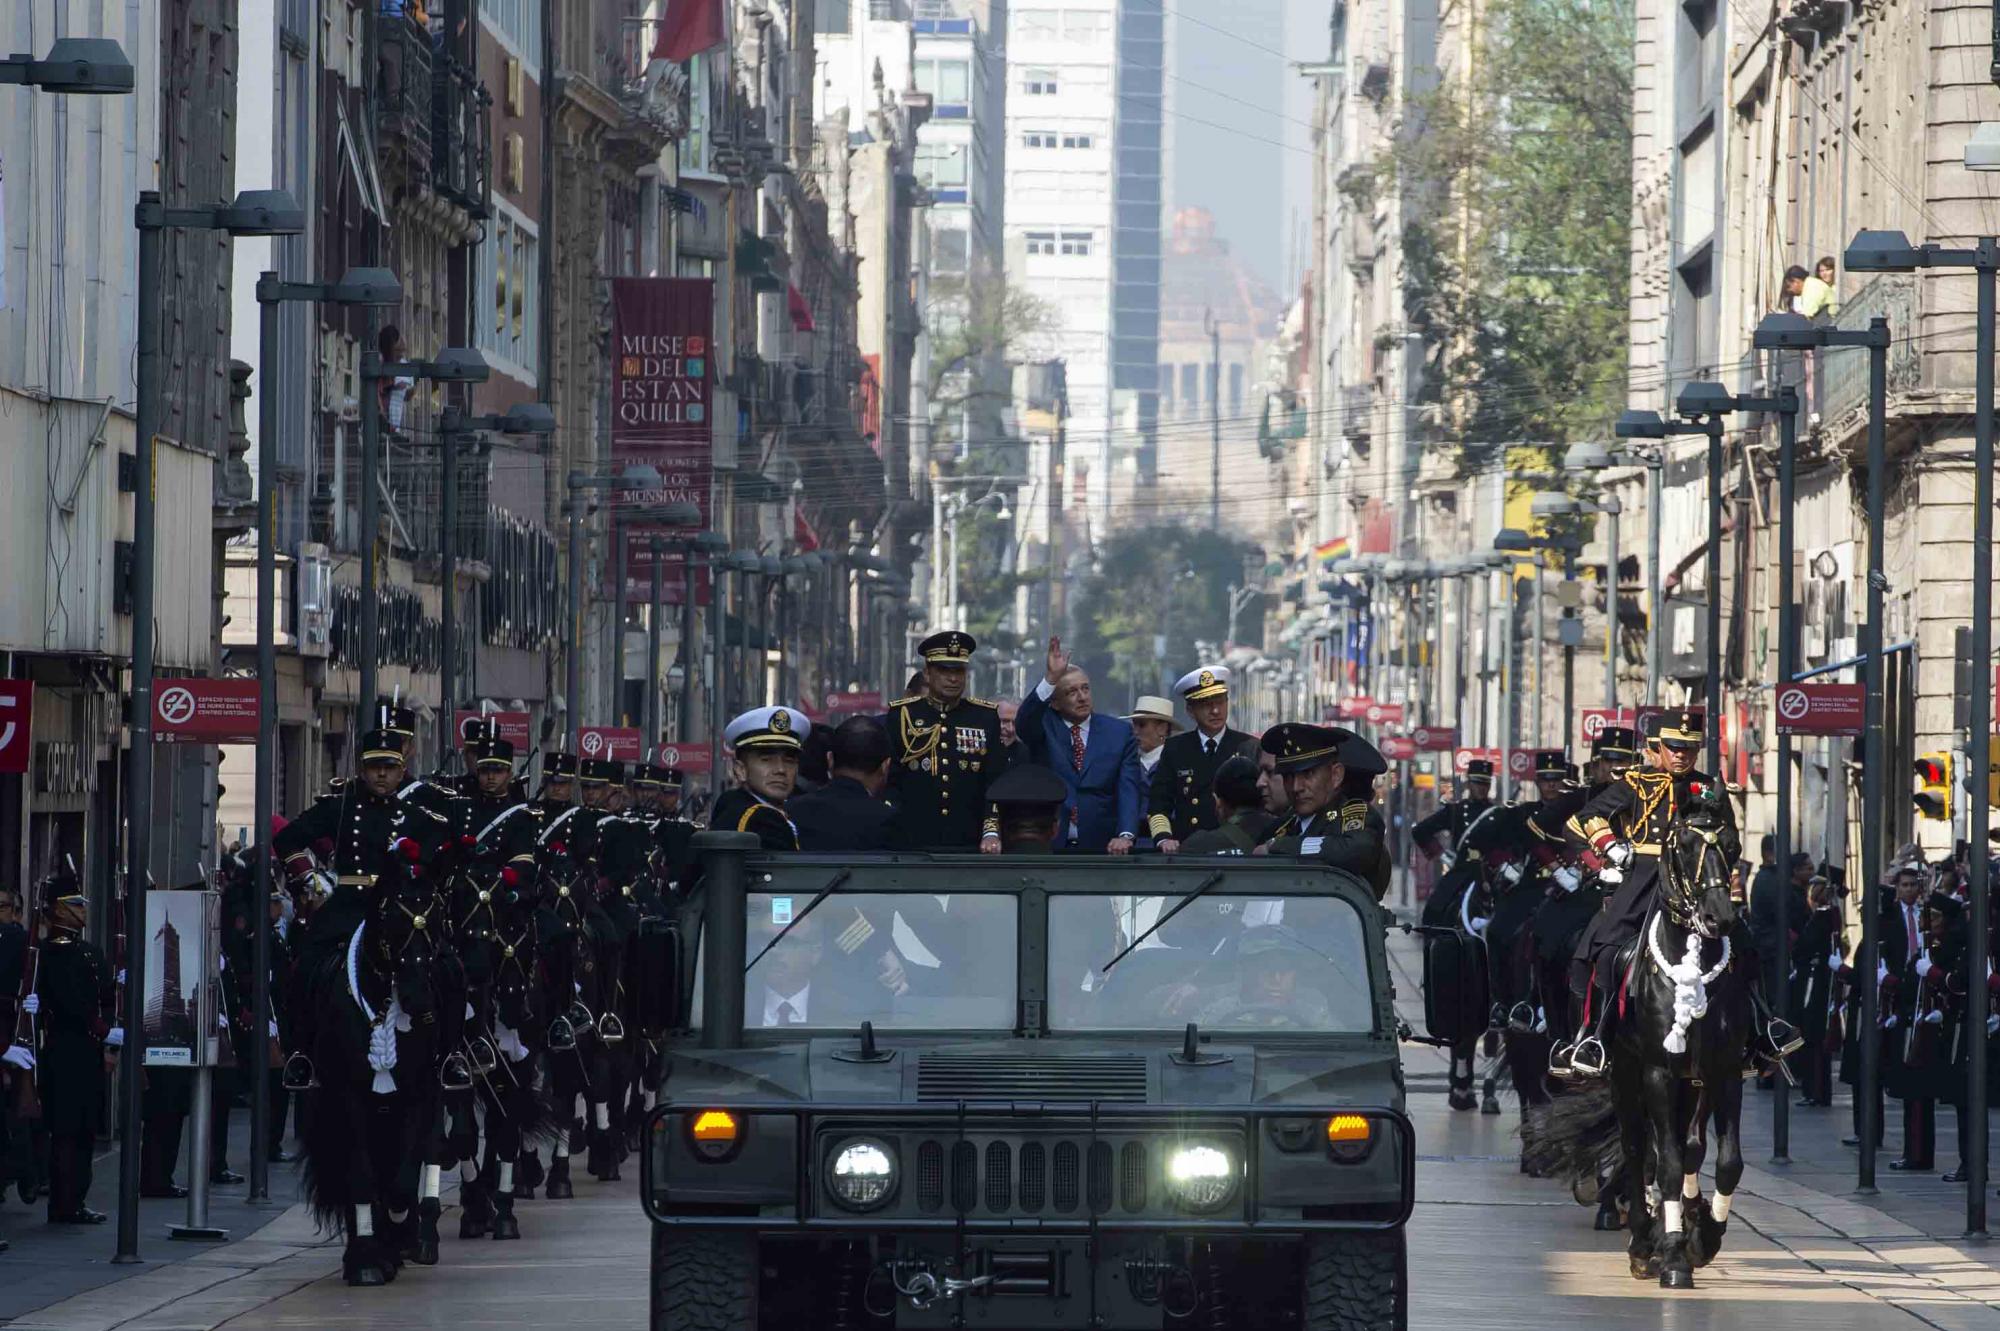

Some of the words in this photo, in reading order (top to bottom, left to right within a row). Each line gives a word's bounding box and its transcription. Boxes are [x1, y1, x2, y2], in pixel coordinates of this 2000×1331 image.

[644, 358, 684, 377] DEL
[622, 380, 702, 400] ESTAN
[663, 474, 690, 487] LOS
